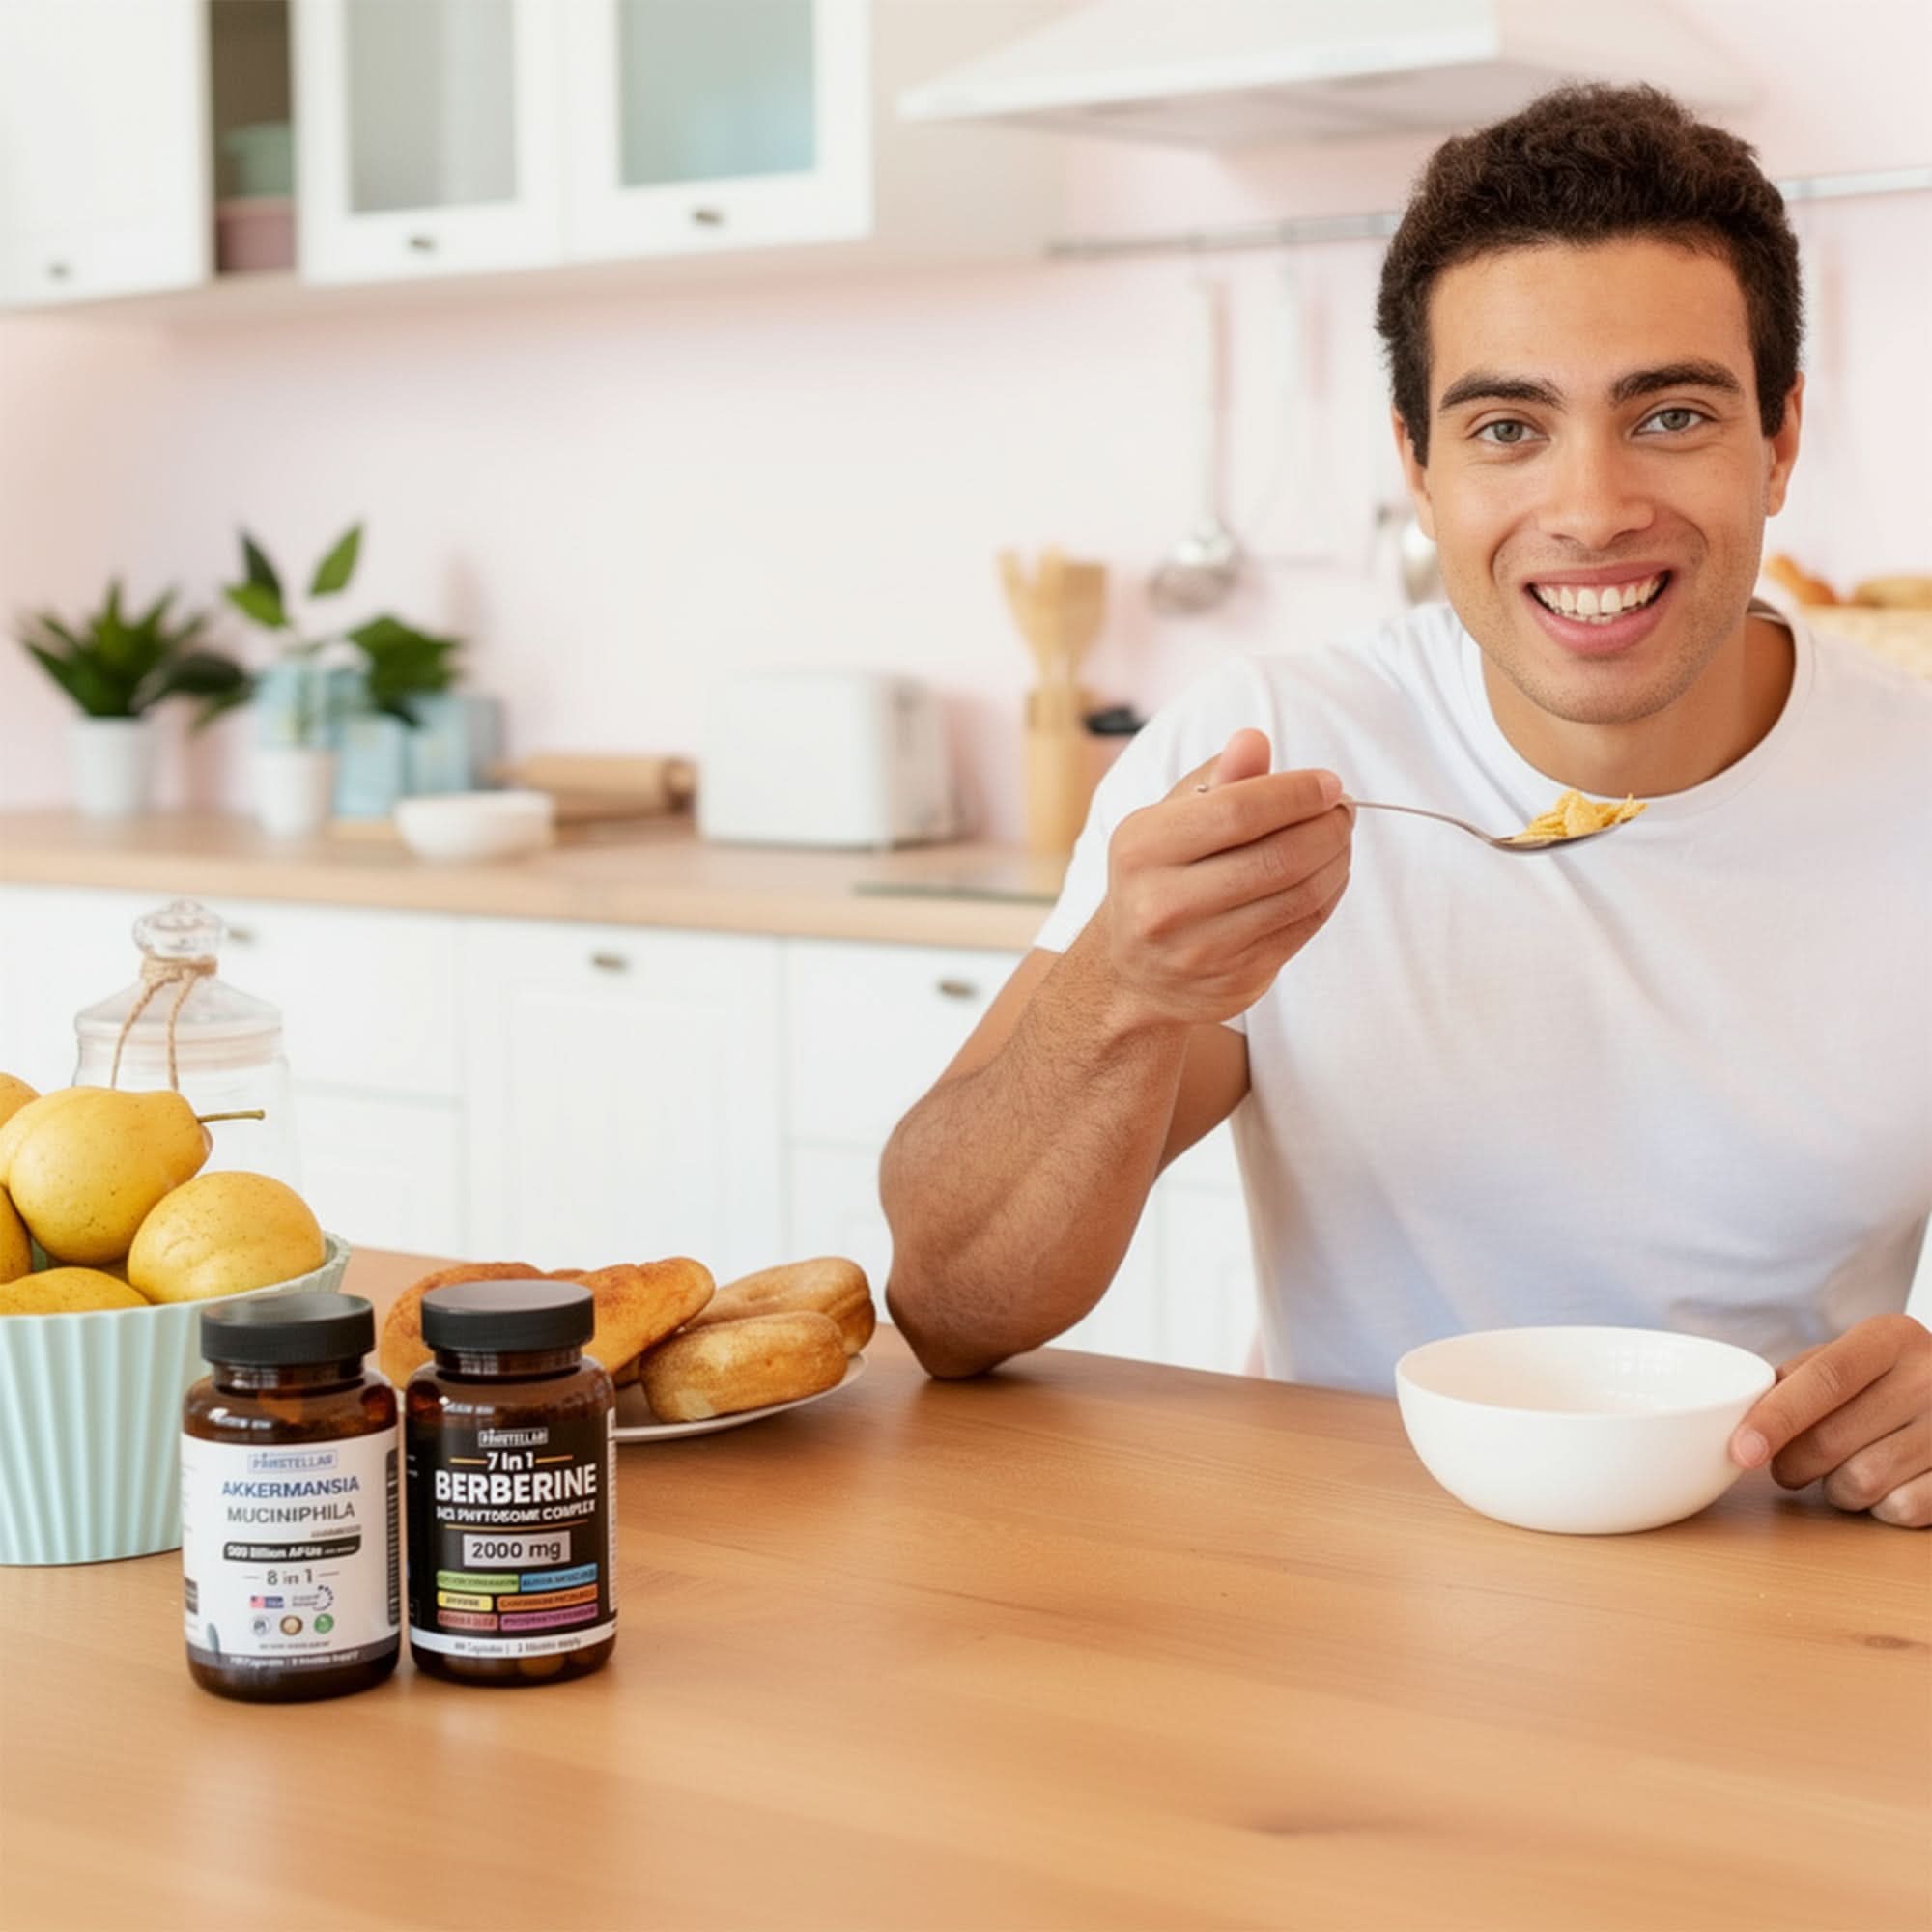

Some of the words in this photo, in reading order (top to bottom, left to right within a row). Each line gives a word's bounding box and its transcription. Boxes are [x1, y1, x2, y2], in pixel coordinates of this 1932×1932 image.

[487, 1452, 499, 1470] 7
[526, 1451, 534, 1468] 1
[222, 1476, 360, 1498] AKKERMANSIA
[435, 1463, 597, 1504] BERBERINE
[227, 1502, 355, 1523] MUCINIPHILA
[542, 1499, 596, 1520] COMPLEX
[471, 1541, 523, 1559] 2000
[528, 1542, 561, 1561] mg
[267, 1570, 278, 1585] 8
[283, 1571, 299, 1585] in
[306, 1569, 313, 1583] 1
